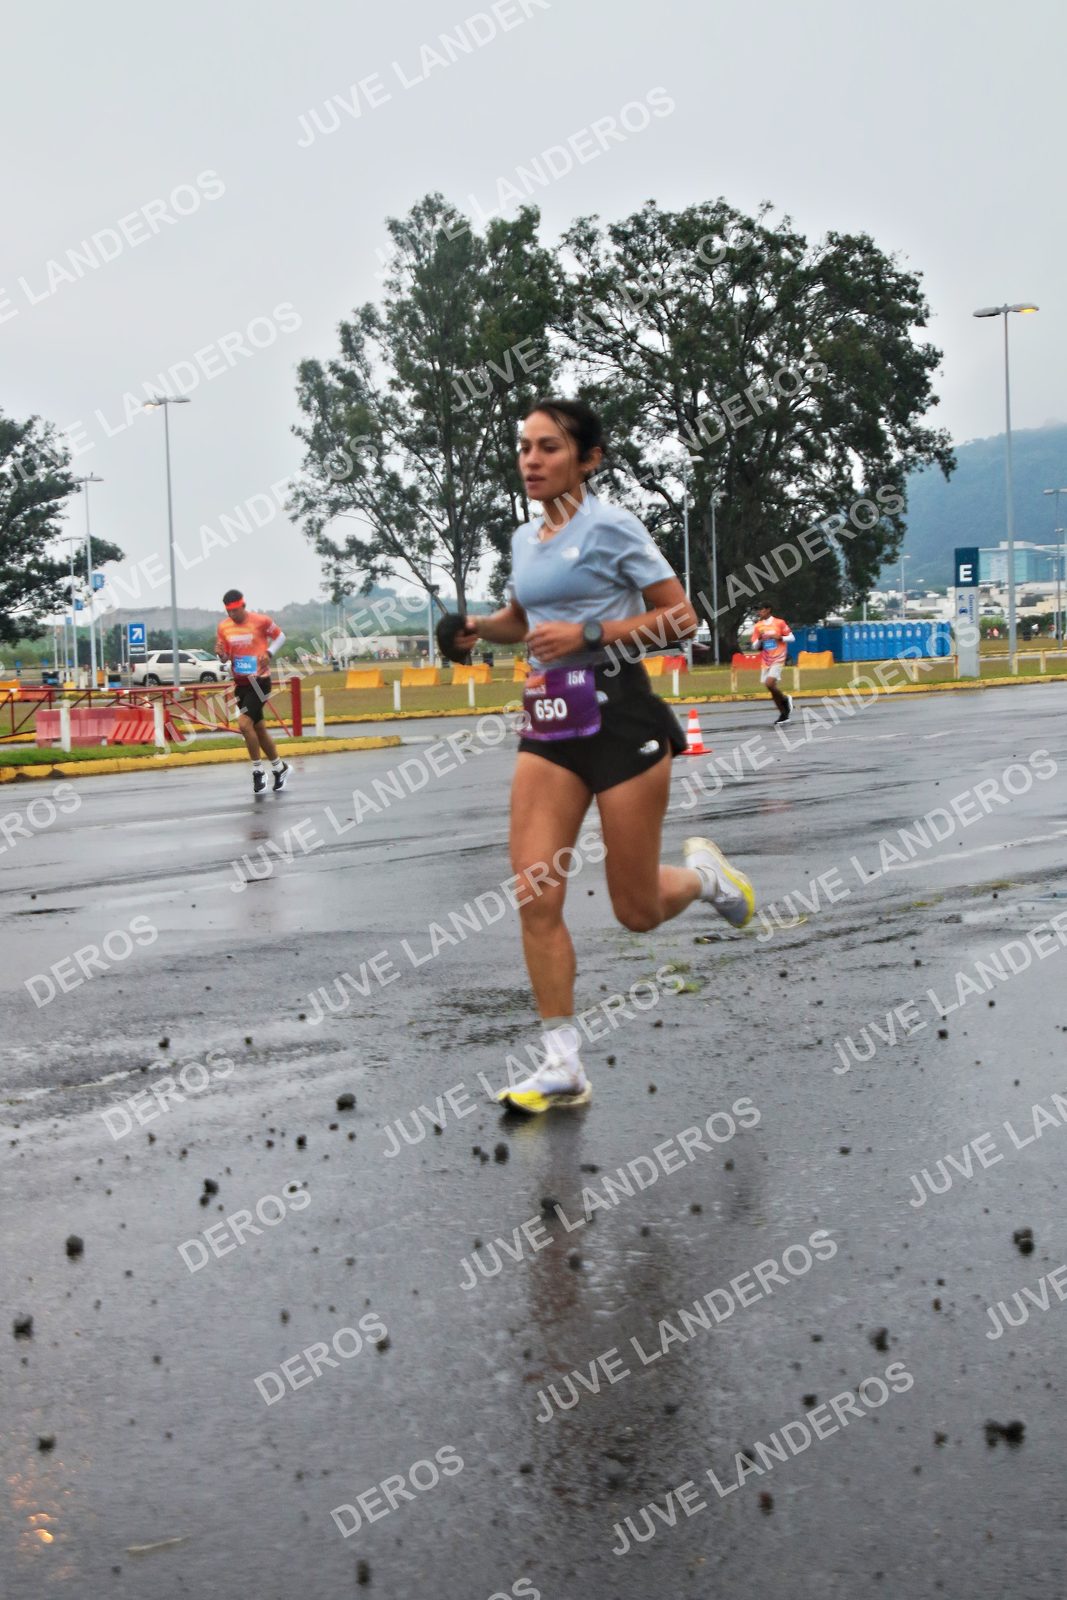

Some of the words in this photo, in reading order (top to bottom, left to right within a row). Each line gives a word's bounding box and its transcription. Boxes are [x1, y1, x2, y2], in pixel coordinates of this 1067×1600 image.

[959, 564, 972, 582] E
[567, 670, 586, 686] 15K
[534, 697, 568, 720] 650
